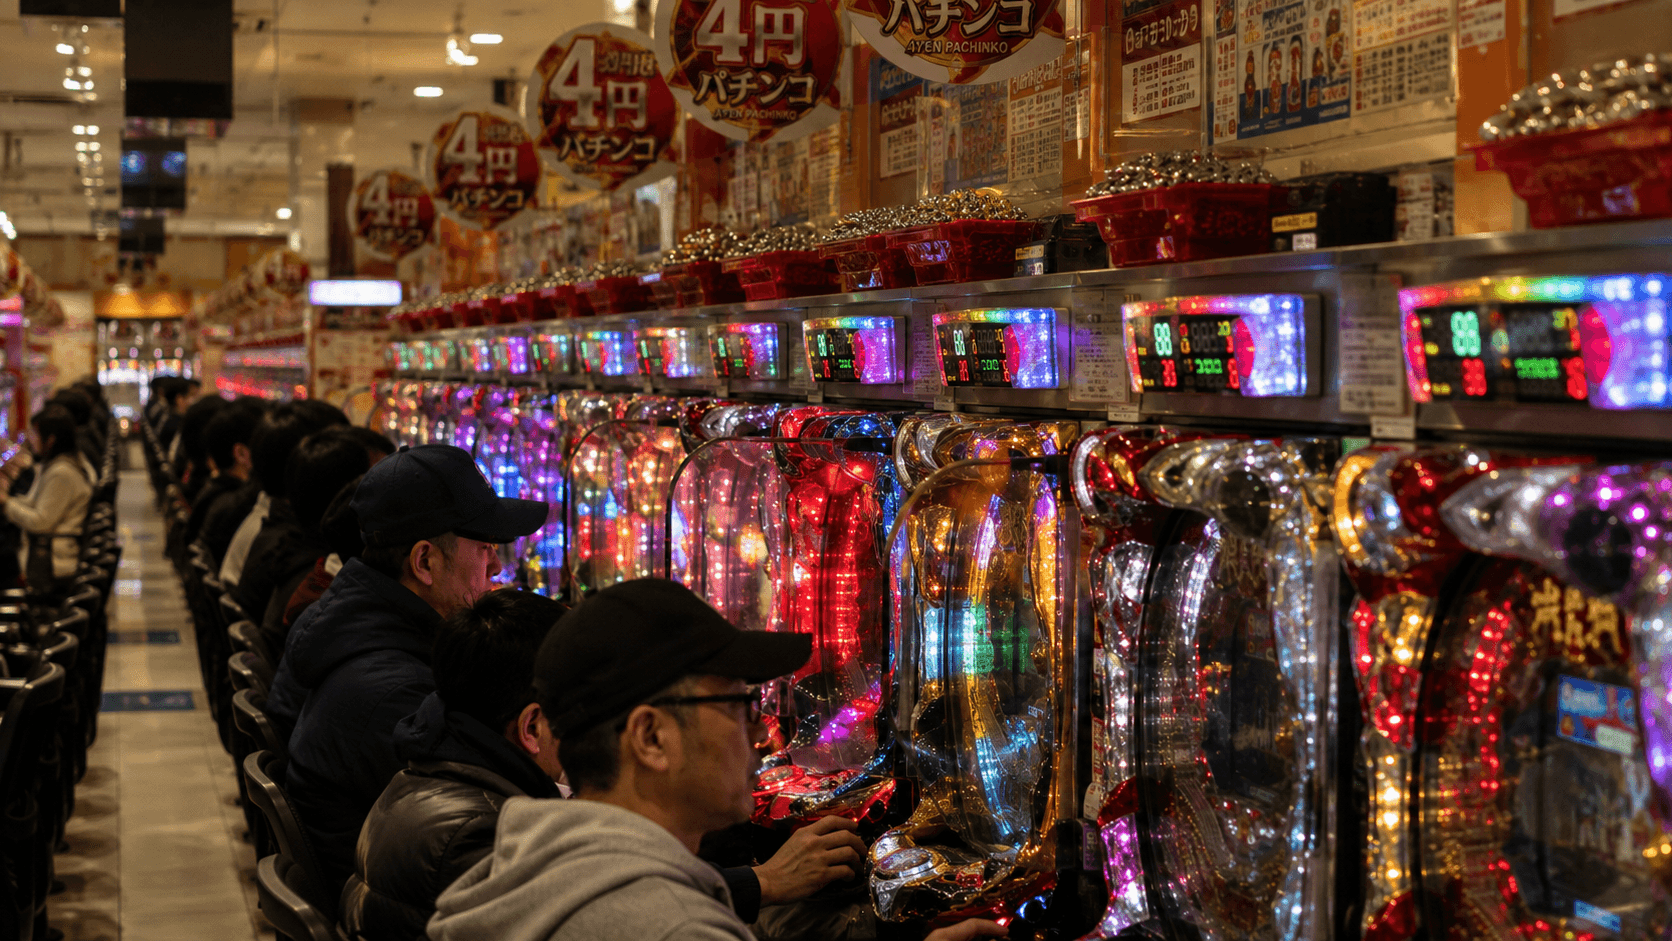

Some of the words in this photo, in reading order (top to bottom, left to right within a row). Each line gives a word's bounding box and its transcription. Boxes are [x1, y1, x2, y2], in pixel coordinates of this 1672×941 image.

[696, 0, 804, 65] 4円
[945, 41, 1008, 54] PACHINKO
[550, 39, 646, 128] 4円
[695, 70, 815, 104] パチンコ
[443, 116, 518, 184] 4円
[559, 133, 655, 161] パチンコ
